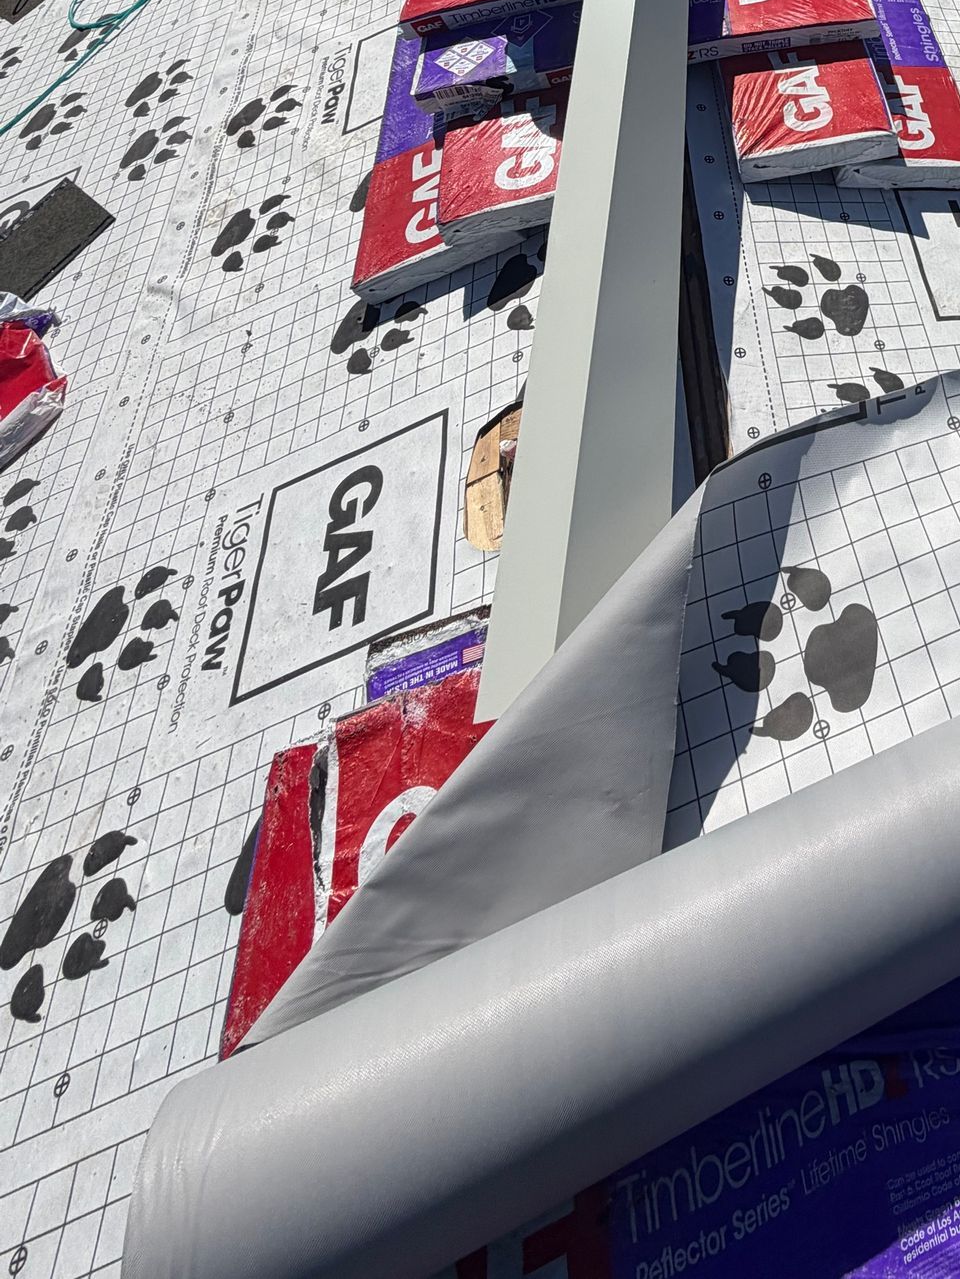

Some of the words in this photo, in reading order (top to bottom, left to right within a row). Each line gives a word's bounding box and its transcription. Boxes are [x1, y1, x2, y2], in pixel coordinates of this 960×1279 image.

[417, 22, 444, 33] GAF
[910, 7, 939, 62] Shingles
[321, 42, 352, 125] TigerPaw
[767, 52, 834, 132] GAF
[880, 66, 936, 151] GAF
[124, 442, 135, 459] Use
[108, 481, 123, 510] Plastic
[101, 509, 114, 528] Cap
[90, 550, 99, 561] or
[205, 514, 229, 578] Premium
[312, 464, 384, 631] GAF
[81, 561, 97, 594] Plastic
[197, 577, 214, 612] Roof
[200, 493, 264, 671] TigerPaw
[74, 592, 87, 614] Cap
[185, 613, 206, 653] Deck
[51, 663, 65, 687] Use
[409, 672, 424, 683] THE
[426, 669, 433, 678] IN
[436, 661, 458, 675] MADE
[167, 655, 196, 734] Protection
[19, 717, 49, 769] Puntillas
[636, 1227, 726, 1279] Reflector
[871, 1106, 950, 1154] Shingles
[900, 1229, 925, 1251] Code
[926, 1222, 936, 1239] of
[938, 1217, 952, 1234] Los
[903, 1233, 948, 1264] residential
